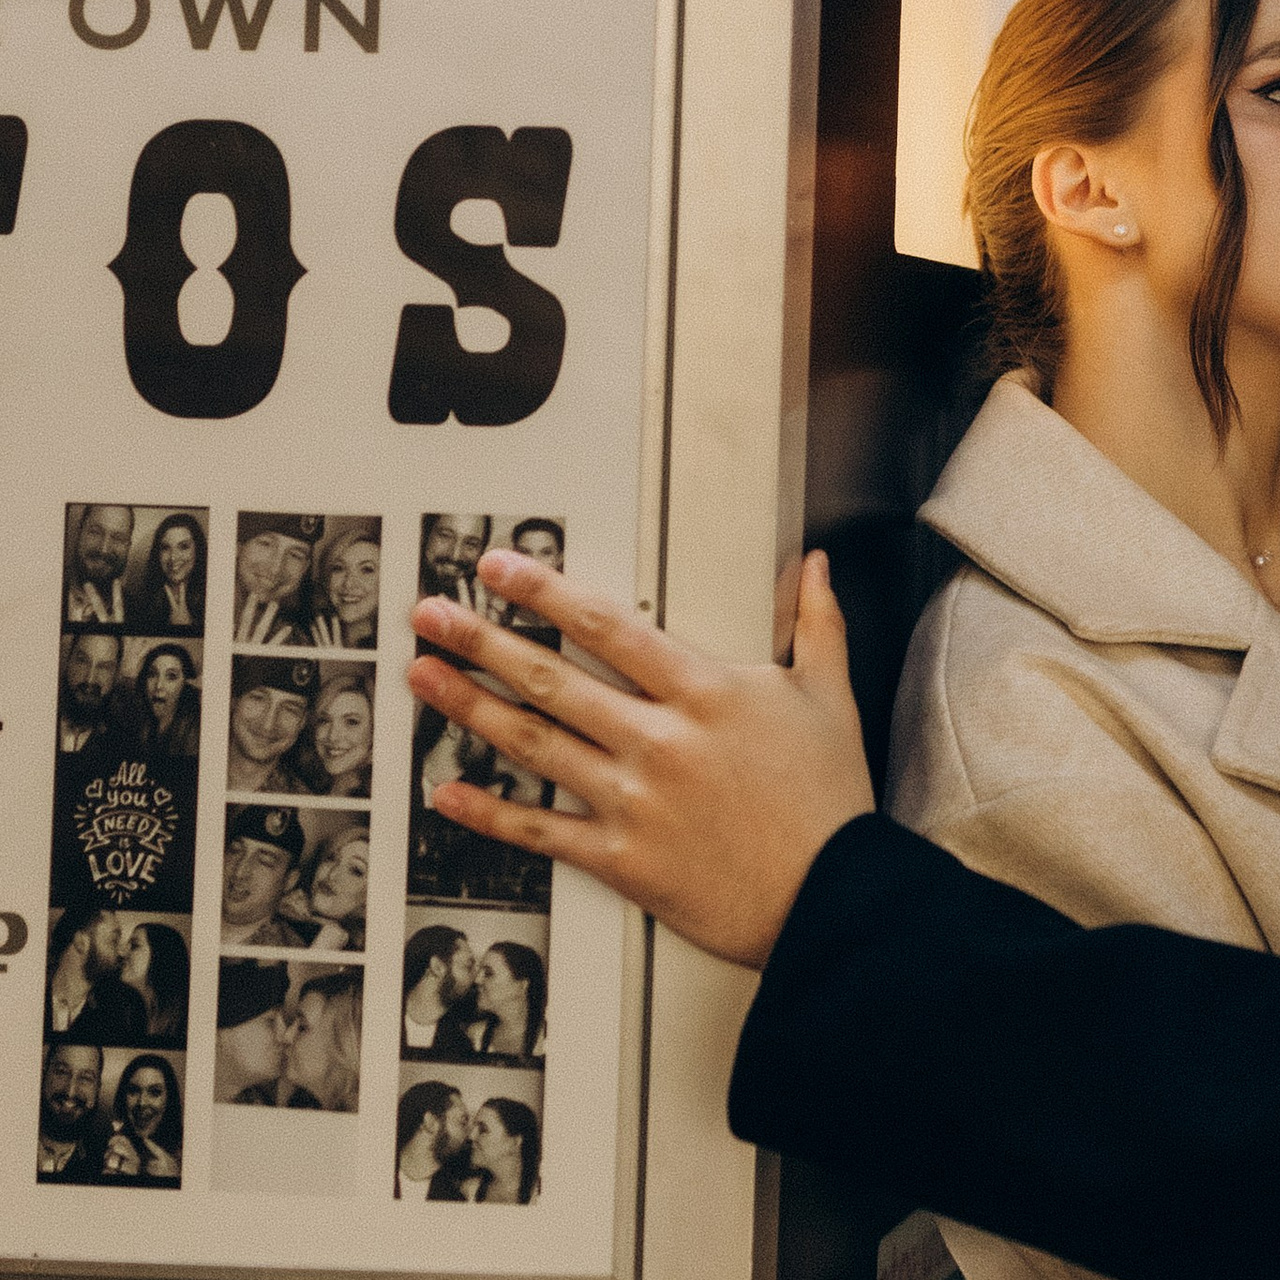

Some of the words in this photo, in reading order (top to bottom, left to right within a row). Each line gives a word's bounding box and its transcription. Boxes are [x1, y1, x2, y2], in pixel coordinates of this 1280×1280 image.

[0, 115, 574, 427] OS
[109, 761, 148, 787] All
[95, 790, 149, 814] you
[104, 815, 150, 833] NEED
[88, 850, 163, 883] LOVE
